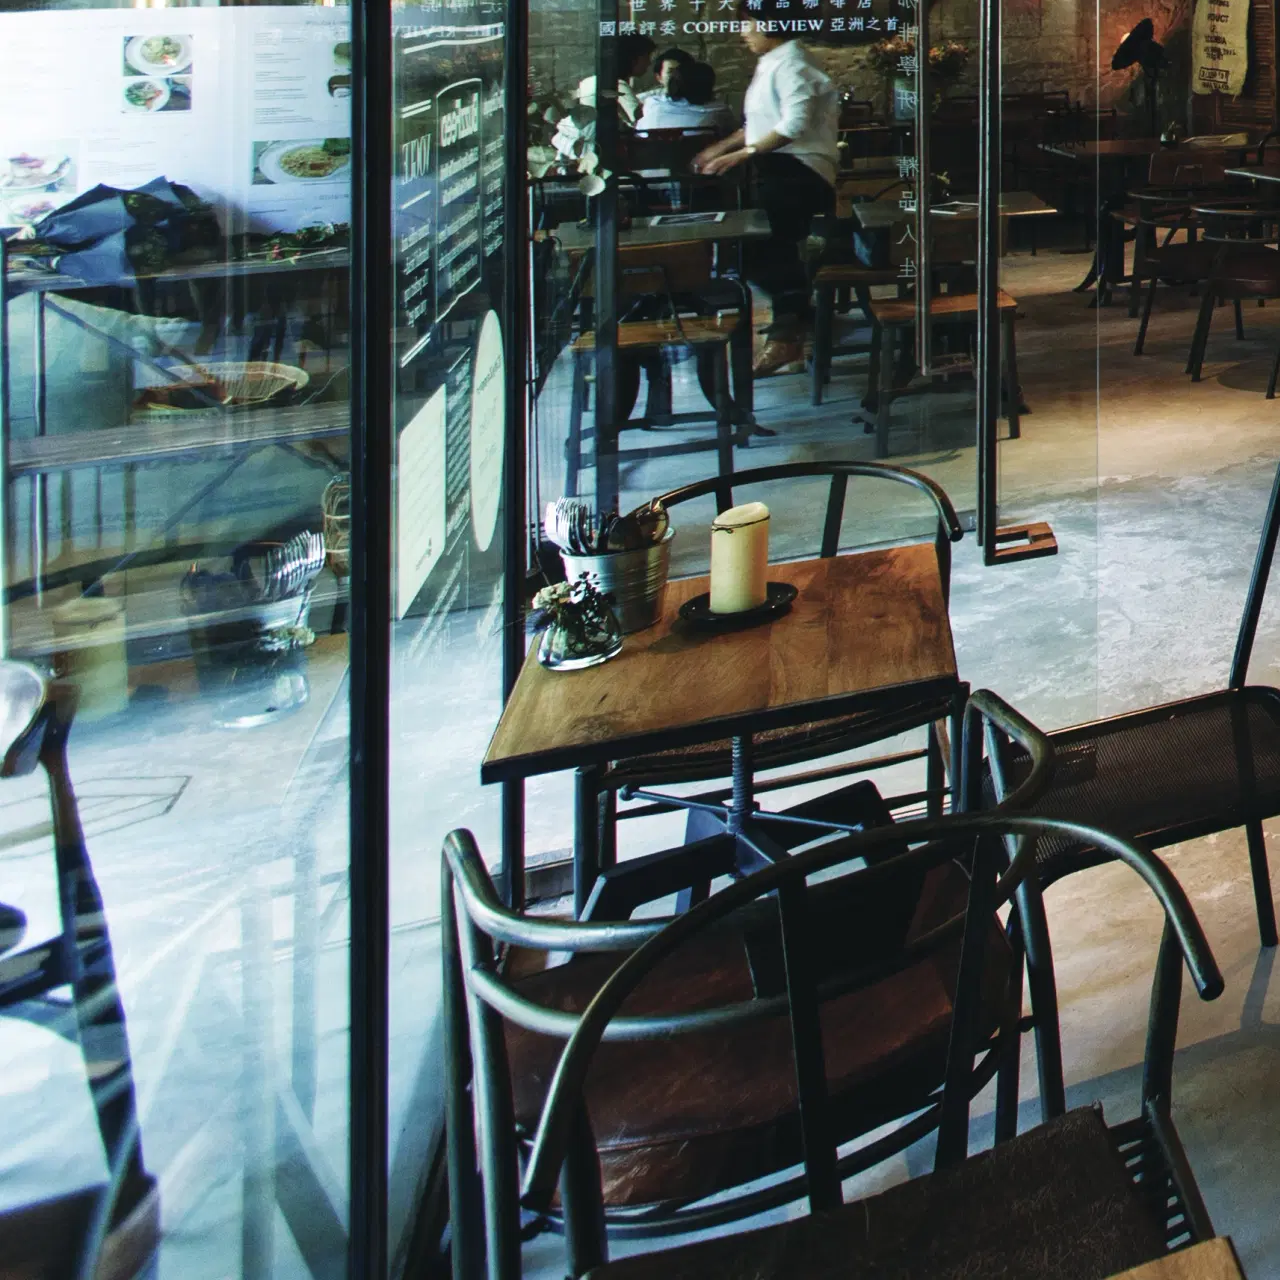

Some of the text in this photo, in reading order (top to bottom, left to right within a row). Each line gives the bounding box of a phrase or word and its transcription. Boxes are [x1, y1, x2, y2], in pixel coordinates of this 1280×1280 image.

[599, 16, 900, 37] 國際評委 COFFEE REVIEW 亞洲之首
